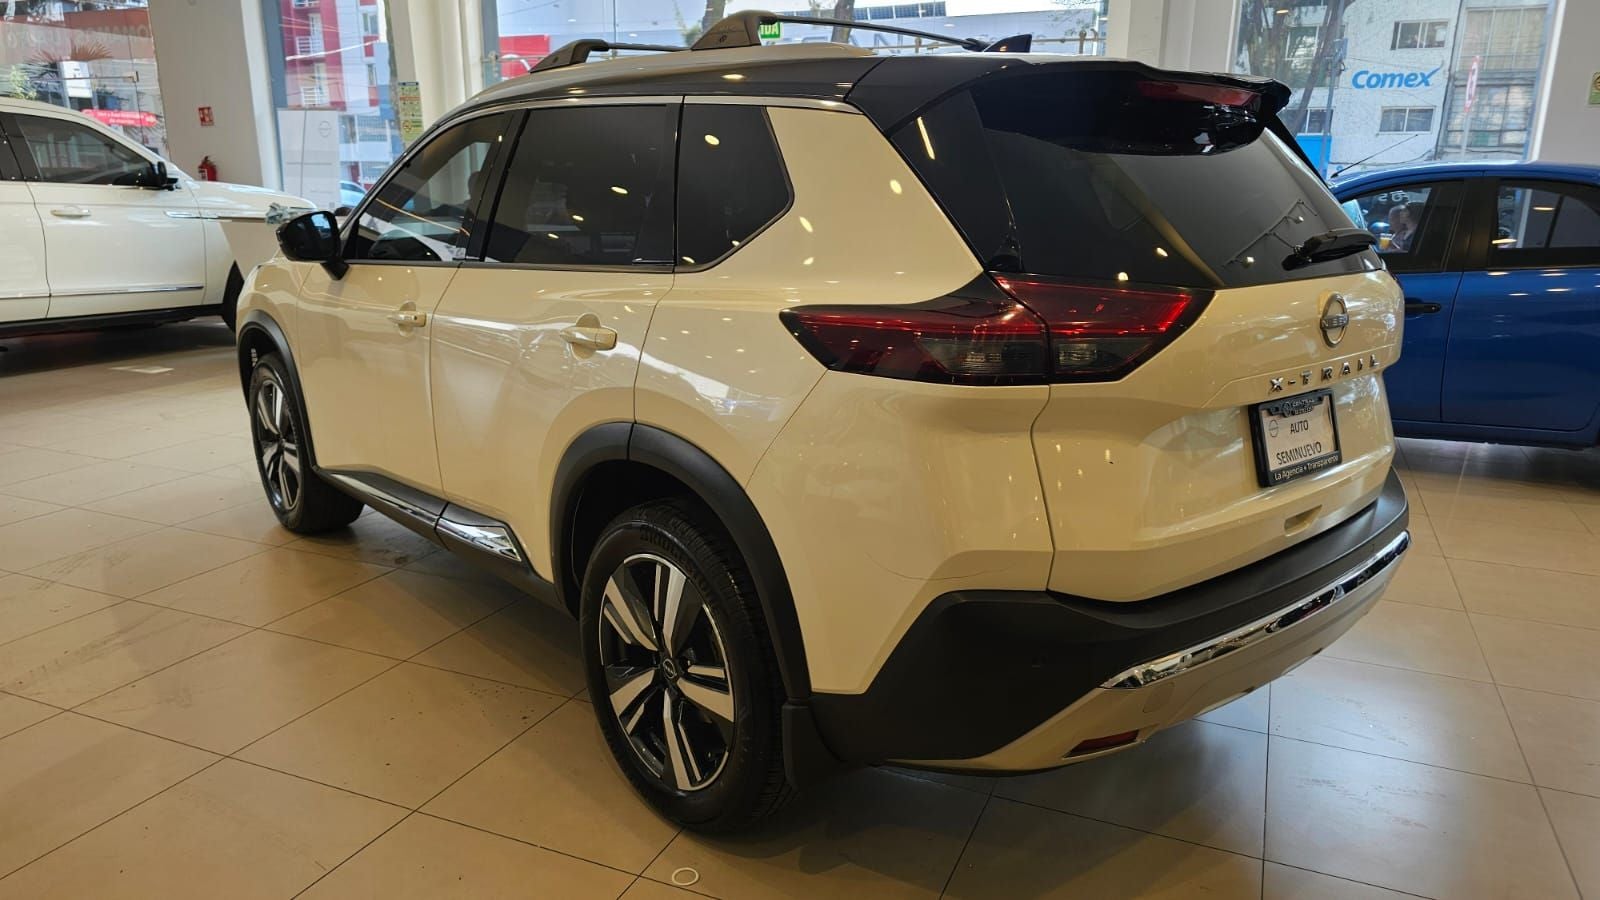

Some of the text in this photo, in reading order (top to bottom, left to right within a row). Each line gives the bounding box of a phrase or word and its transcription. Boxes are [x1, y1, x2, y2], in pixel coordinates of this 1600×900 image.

[1352, 60, 1443, 89] Comex
[1269, 353, 1380, 392] X-TRAIL
[1290, 420, 1309, 434] AUTO
[1276, 441, 1322, 465] SEMINUEVO
[1274, 472, 1282, 481] La
[1282, 465, 1304, 479] Agencia
